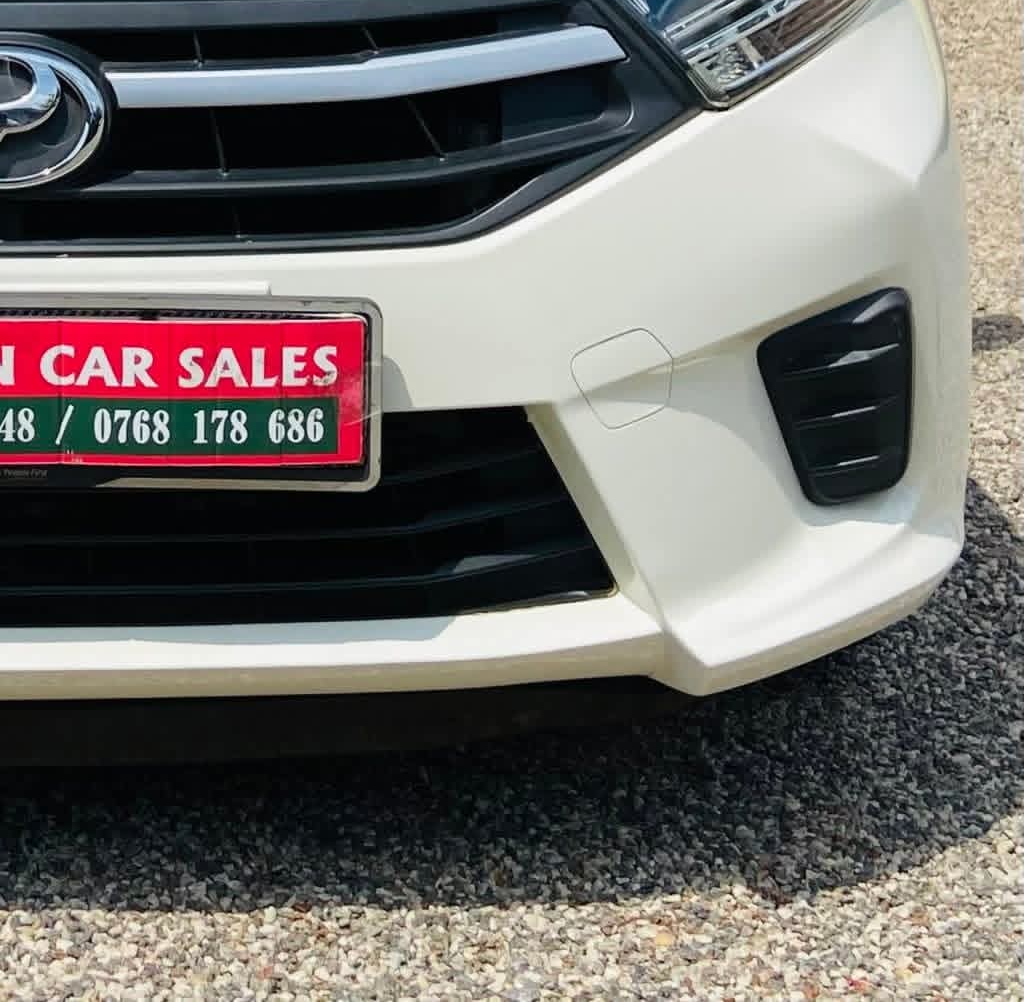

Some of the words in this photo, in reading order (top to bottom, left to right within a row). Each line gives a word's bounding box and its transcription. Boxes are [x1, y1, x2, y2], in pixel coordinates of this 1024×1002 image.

[39, 344, 159, 388] CAR
[177, 345, 338, 388] SALES
[93, 407, 171, 445] 0768
[193, 409, 248, 445] 178
[267, 408, 325, 444] 686
